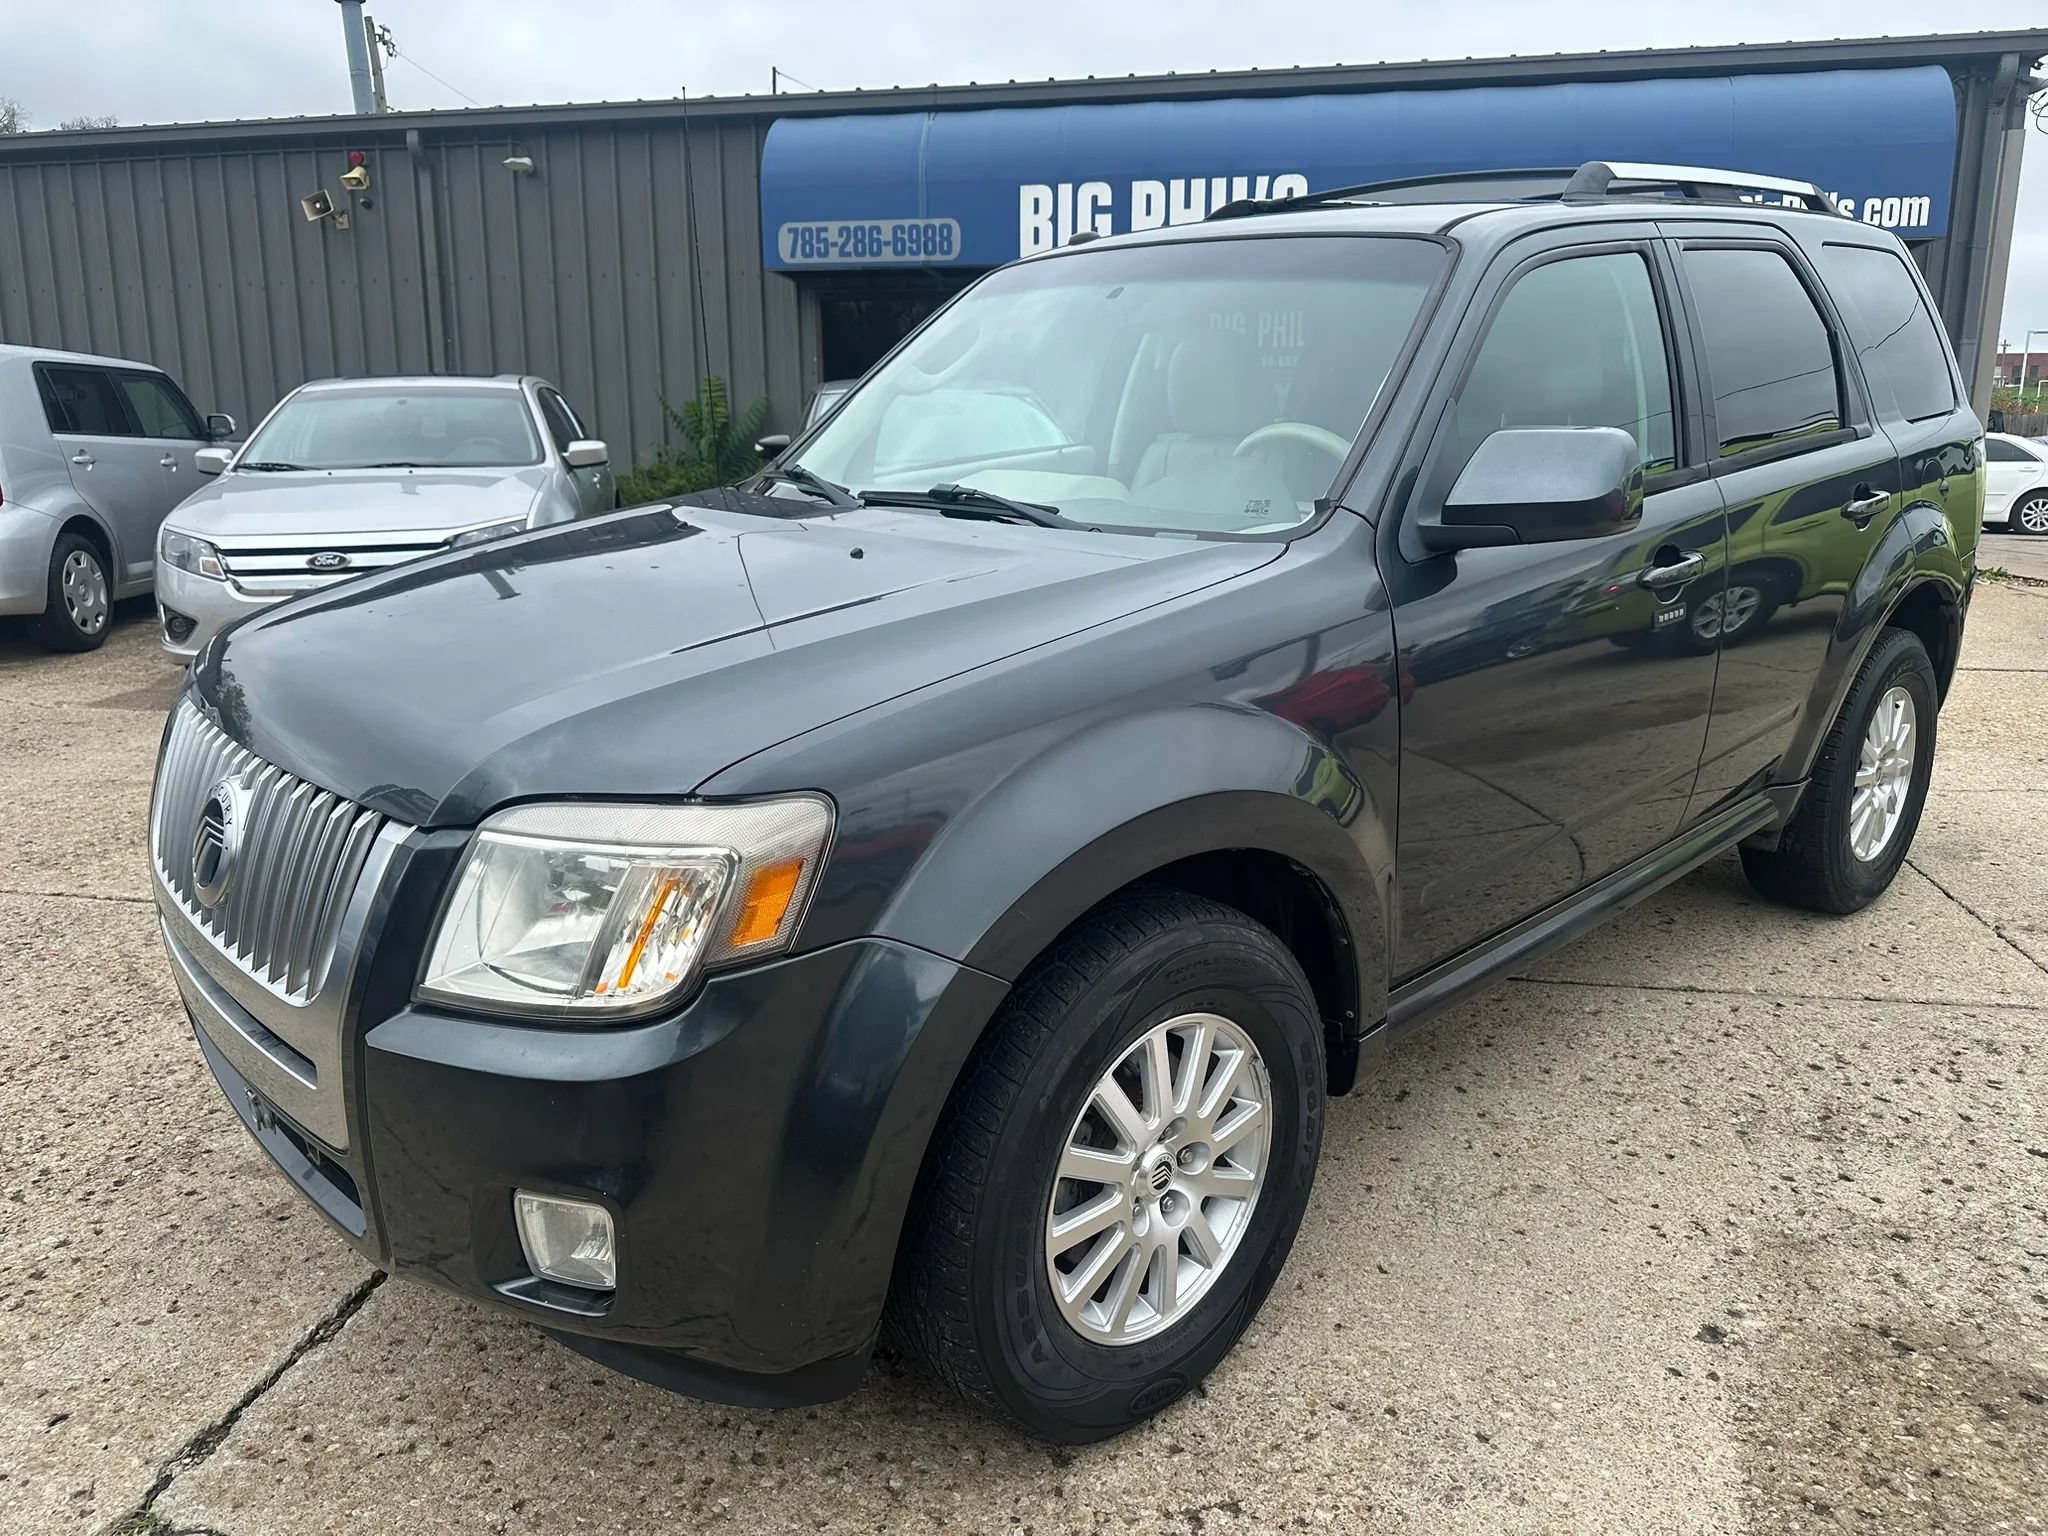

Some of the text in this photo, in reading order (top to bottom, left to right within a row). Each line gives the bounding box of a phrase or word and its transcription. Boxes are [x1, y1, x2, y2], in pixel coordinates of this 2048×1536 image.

[1020, 181, 1112, 258] BIG
[787, 223, 953, 259] 785-286-6988
[315, 555, 340, 566] Ford
